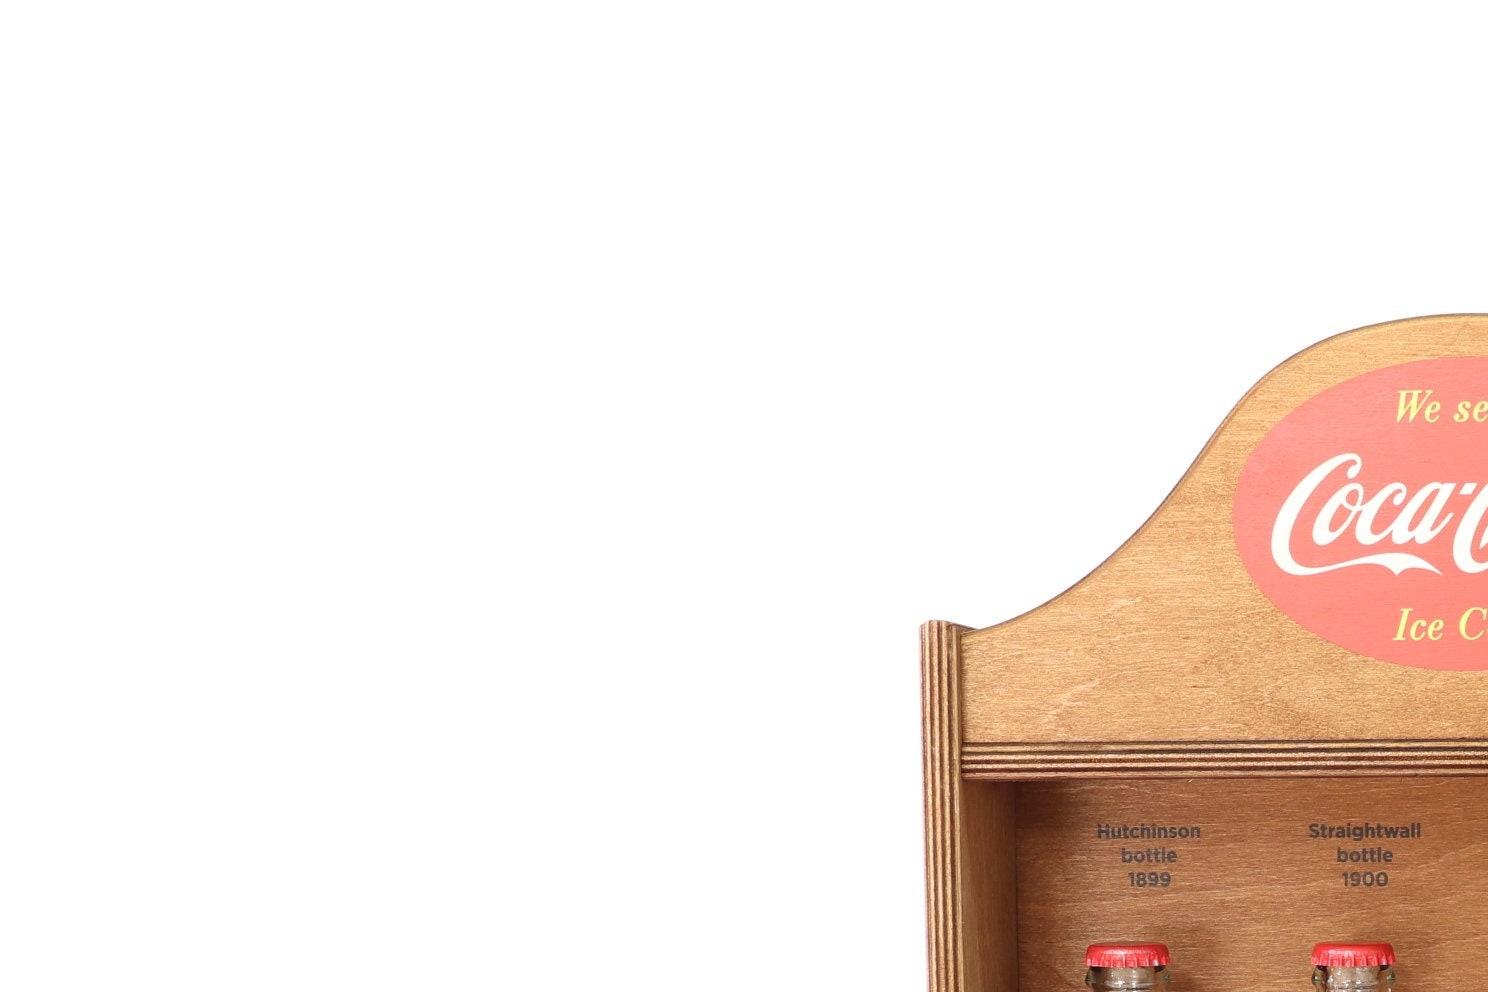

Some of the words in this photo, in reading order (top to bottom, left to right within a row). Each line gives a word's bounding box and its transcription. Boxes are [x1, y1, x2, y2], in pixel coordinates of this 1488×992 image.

[1393, 390, 1441, 423] We
[1393, 608, 1443, 641] Ice
[1097, 823, 1200, 839] Hutchinson
[1308, 823, 1421, 842] Straightwall
[1121, 847, 1177, 864] bottle
[1336, 847, 1393, 863] bottle
[1128, 872, 1171, 887] 1899
[1343, 872, 1388, 887] 1900
